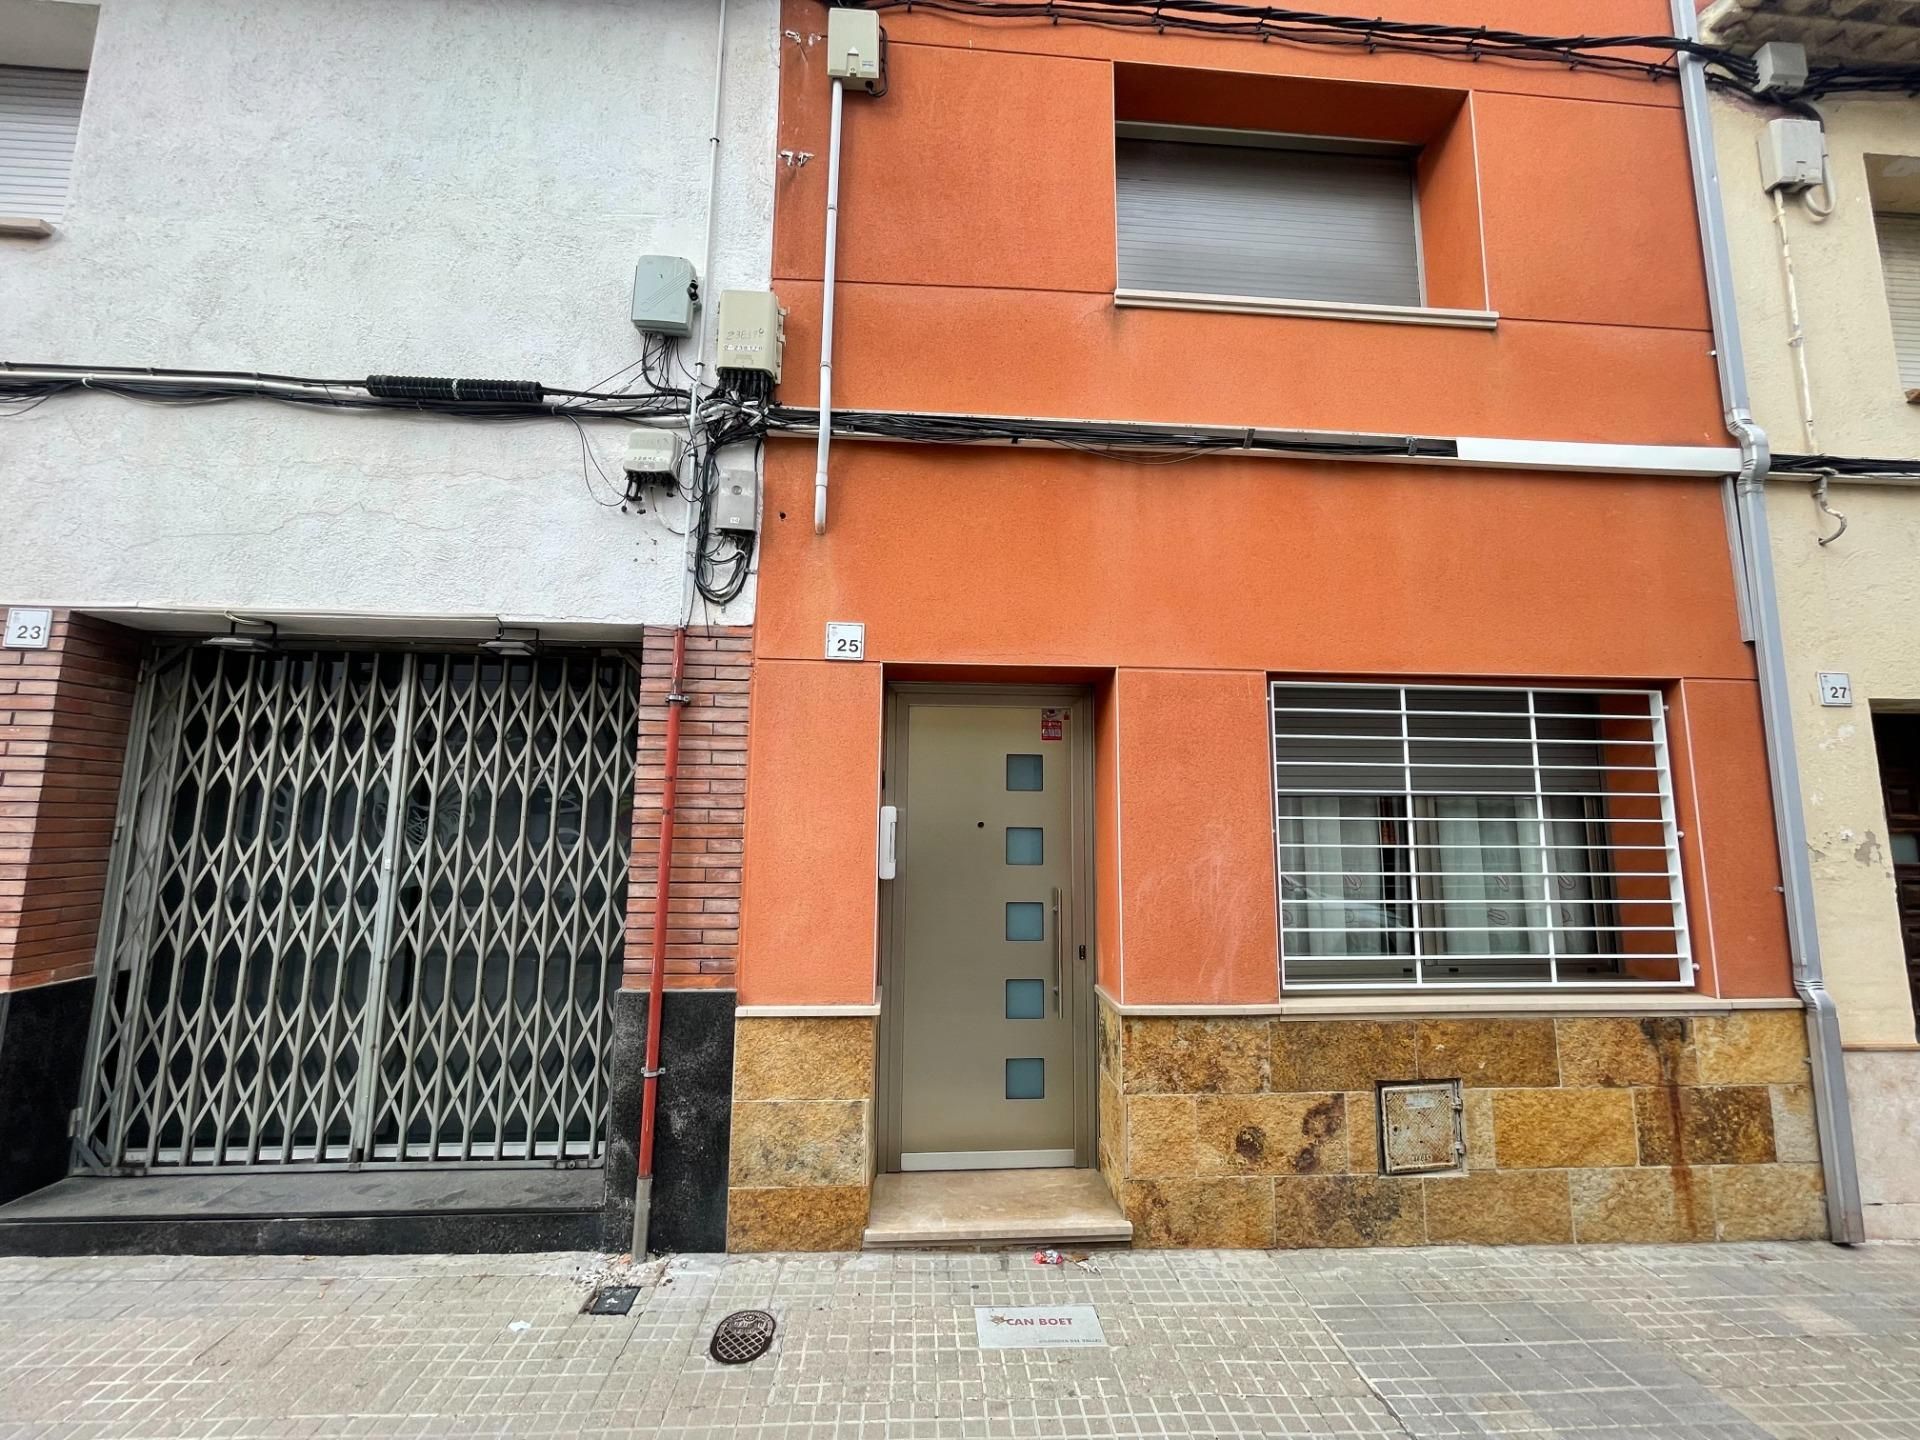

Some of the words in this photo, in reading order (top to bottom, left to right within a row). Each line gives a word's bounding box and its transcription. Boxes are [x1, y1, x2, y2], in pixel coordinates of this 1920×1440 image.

[16, 625, 41, 639] 23
[837, 638, 859, 653] 25
[1830, 686, 1847, 698] 27
[1006, 1318, 1034, 1326] CAN
[1038, 1318, 1073, 1326] BOET
